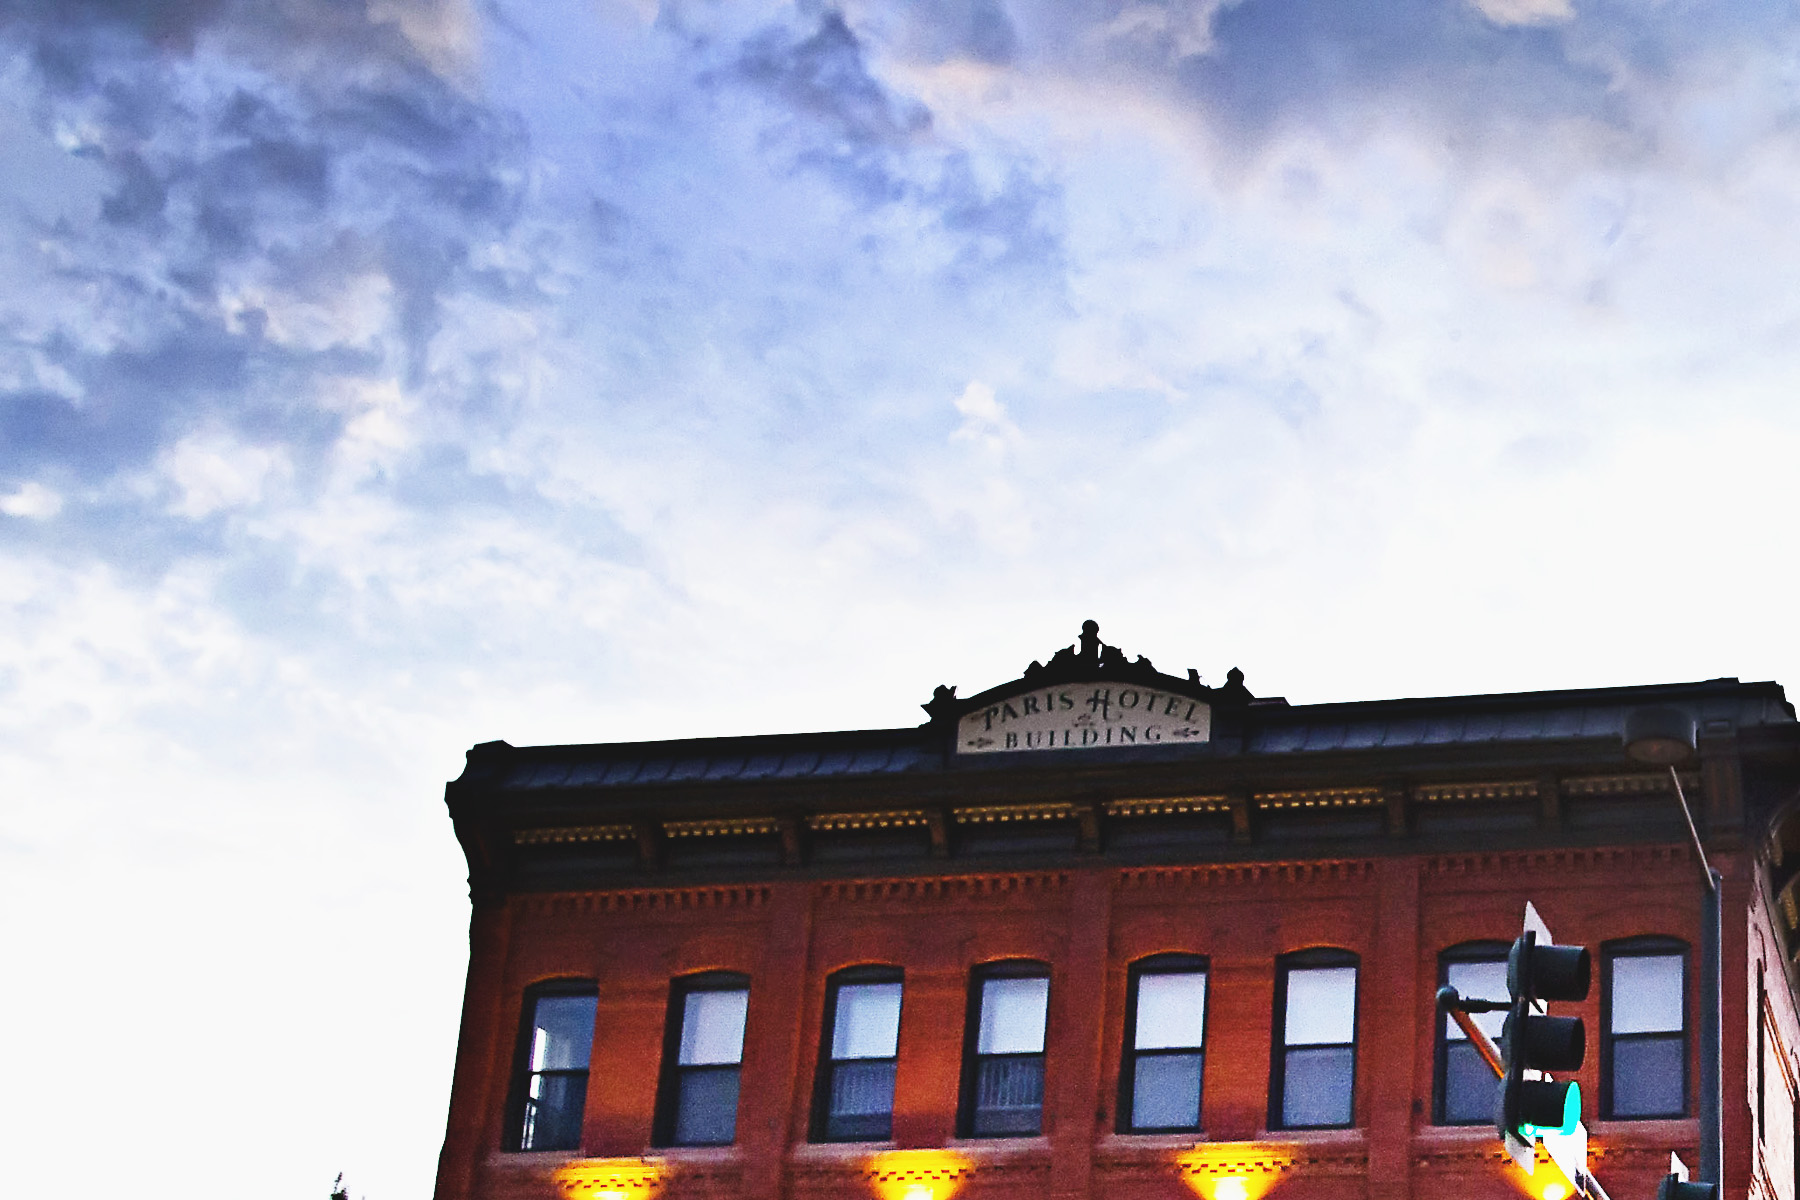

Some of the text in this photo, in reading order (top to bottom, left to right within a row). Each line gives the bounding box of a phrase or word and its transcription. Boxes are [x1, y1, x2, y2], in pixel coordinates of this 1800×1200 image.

[970, 688, 1200, 732] PARIS HOTEL
[1004, 724, 1162, 749] BUILDING
